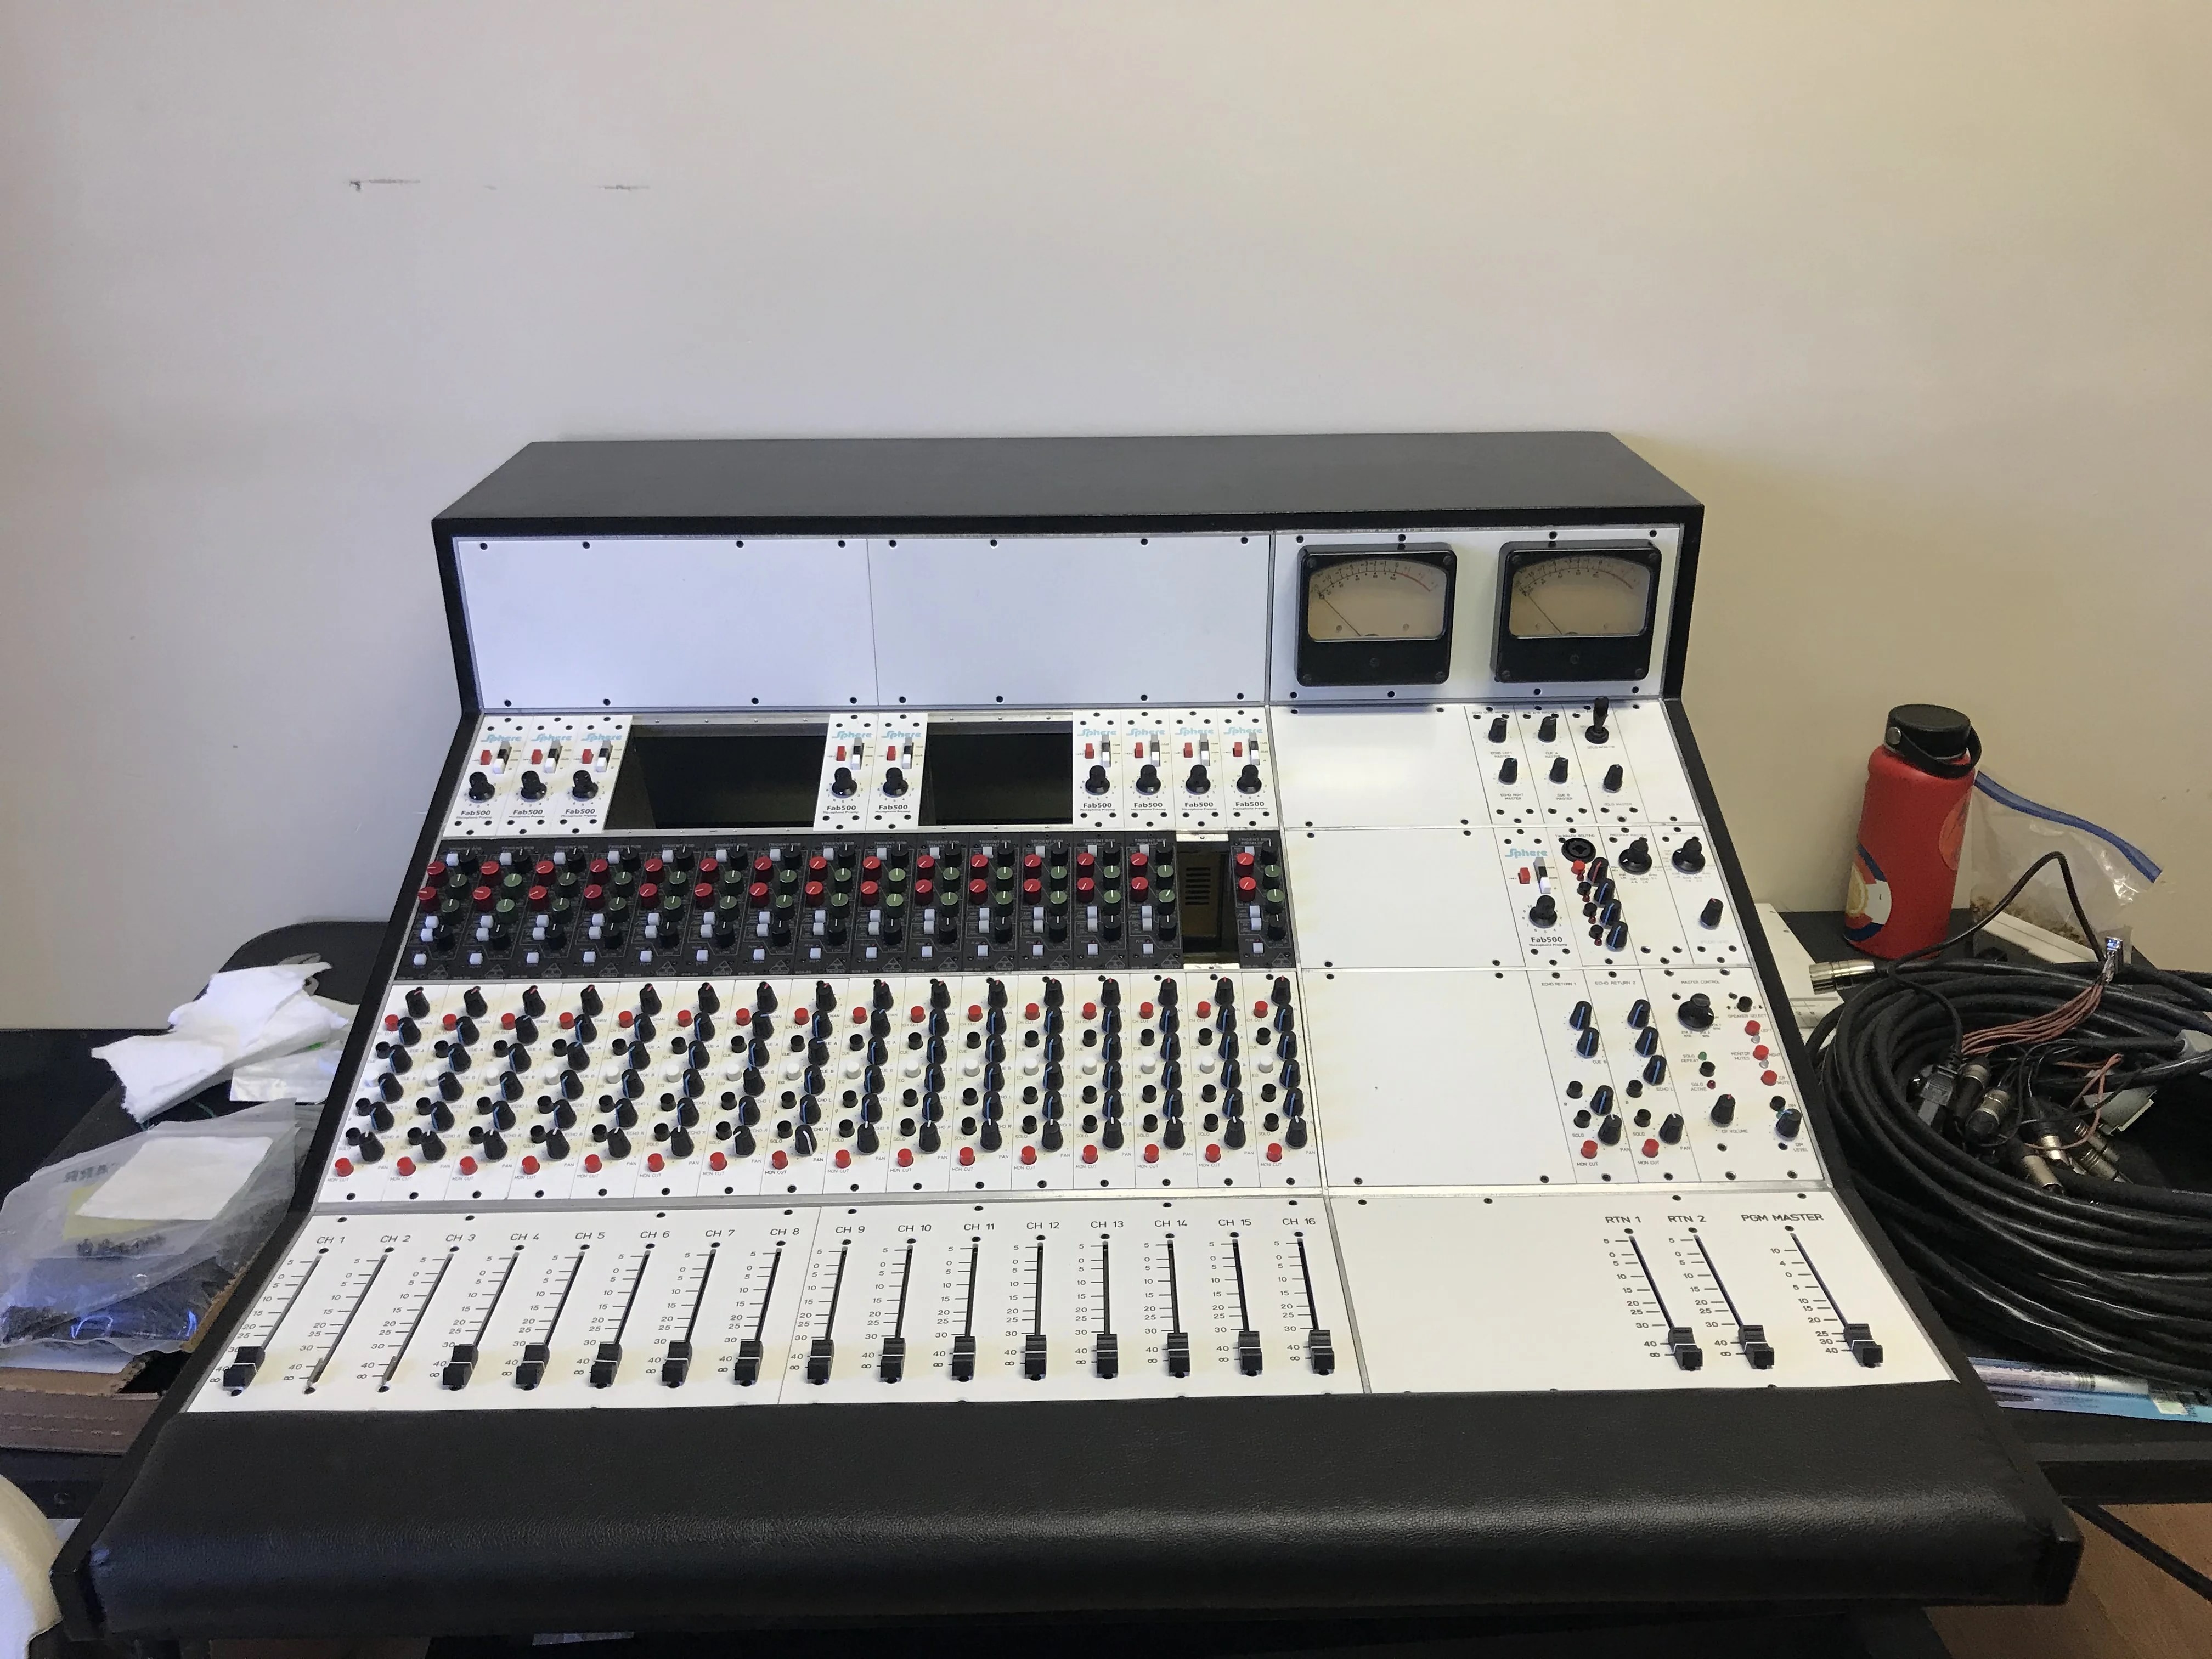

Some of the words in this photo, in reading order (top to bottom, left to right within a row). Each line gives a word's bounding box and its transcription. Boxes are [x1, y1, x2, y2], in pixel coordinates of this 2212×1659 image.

[1224, 727, 1262, 736] Sphere
[581, 733, 622, 741] Sphere
[1505, 849, 1548, 859] Sphere
[1697, 1215, 1707, 1223] 2
[1771, 1213, 1824, 1221] MASTER
[316, 1236, 335, 1244] CH
[380, 1235, 398, 1243] CH
[445, 1234, 464, 1242] CH
[510, 1233, 528, 1241] CH
